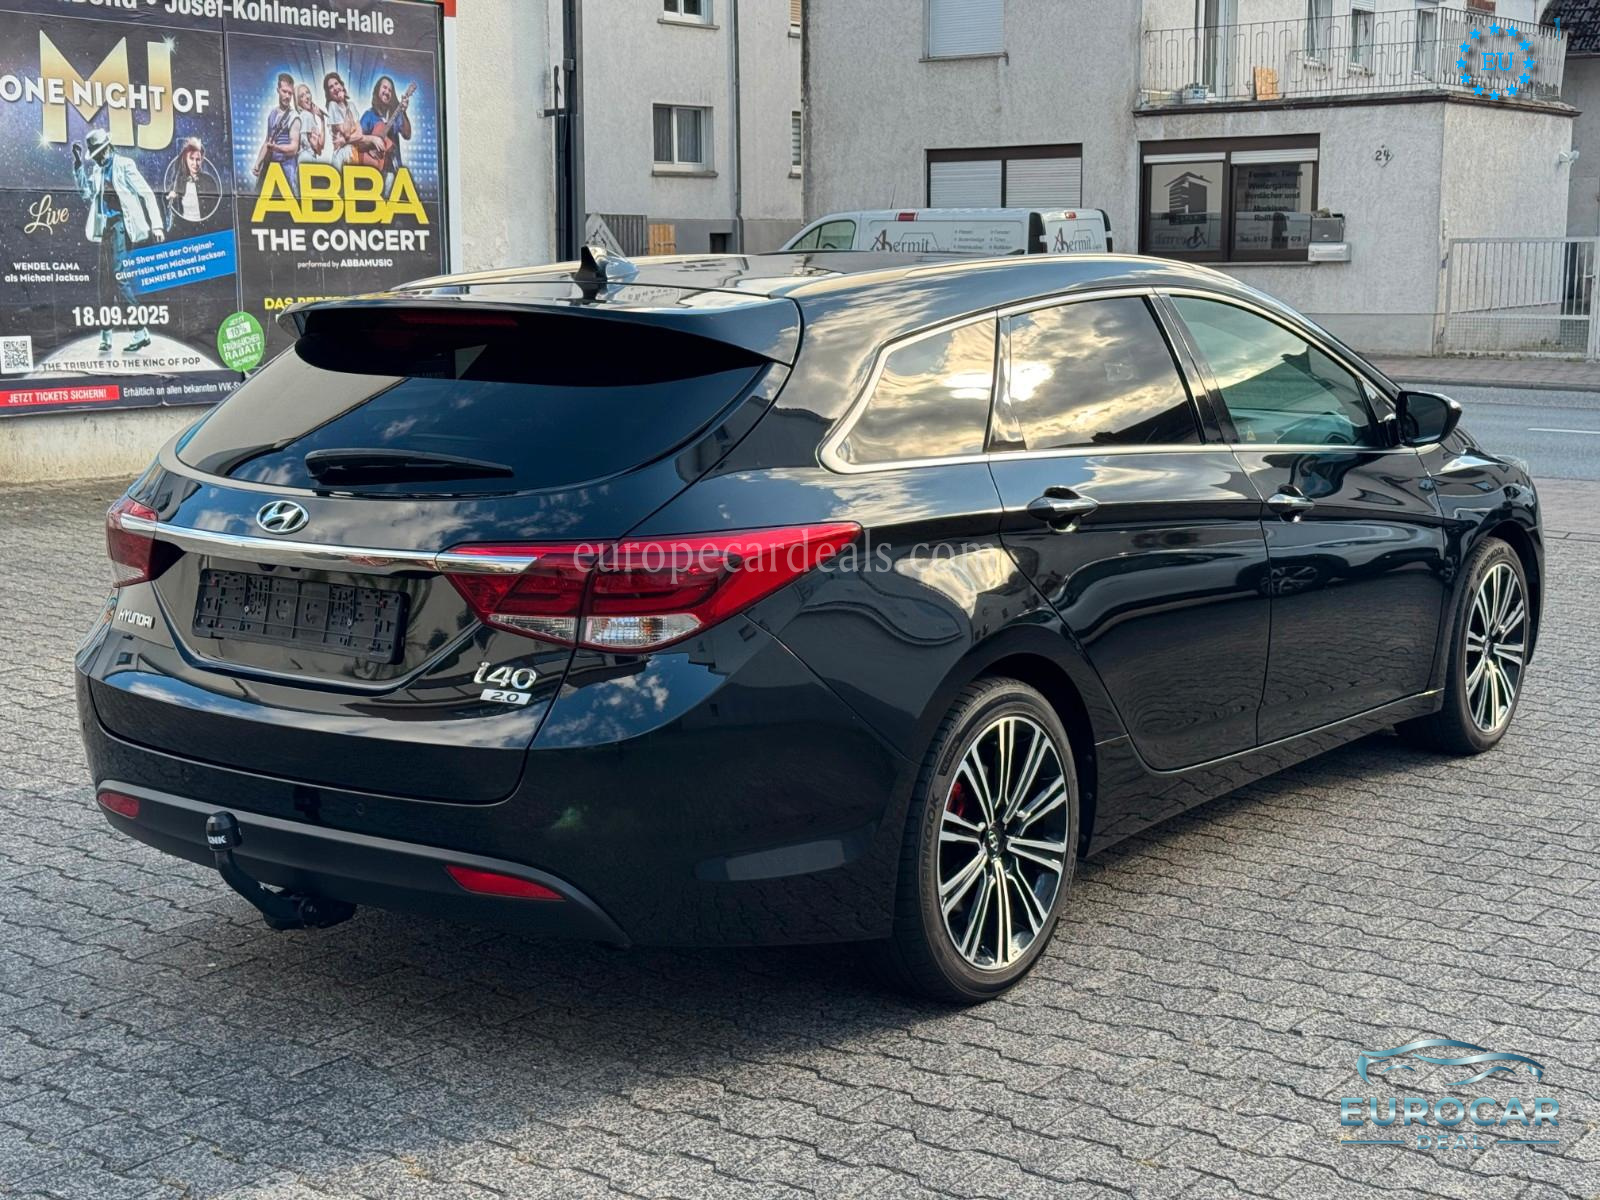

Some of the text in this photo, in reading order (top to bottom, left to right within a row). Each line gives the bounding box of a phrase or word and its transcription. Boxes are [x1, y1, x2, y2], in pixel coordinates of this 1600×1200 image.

[164, 0, 394, 35] Josef-Kohlmaier-Halle
[0, 75, 210, 113] ONE NIGHT OF
[39, 30, 175, 150] MJ
[250, 162, 430, 224] ABBA
[24, 194, 70, 235] Live
[251, 228, 430, 251] THE CONCERT
[13, 262, 51, 271] WENDEL
[123, 259, 135, 268] Die
[136, 253, 155, 264] Show
[156, 250, 168, 261] mit
[169, 247, 181, 257] der
[156, 262, 169, 271] von
[170, 256, 198, 268] Michael
[297, 258, 393, 269] performed by ABBAMUSIC
[4, 273, 90, 283] als Michael Jackson
[178, 265, 206, 279] BATTEN
[264, 297, 293, 311] DAS
[72, 305, 170, 327] 18.09.2025
[42, 356, 201, 372] THE TRIBUTE TO THE KING OF POP
[8, 388, 107, 403] JETZT TICKETS SICHERN!
[123, 382, 241, 397] Erhältlich an allen bekannten VVK-S
[118, 609, 154, 629] HYUNDAI
[473, 661, 537, 690] i40
[491, 691, 520, 702] 2.0
